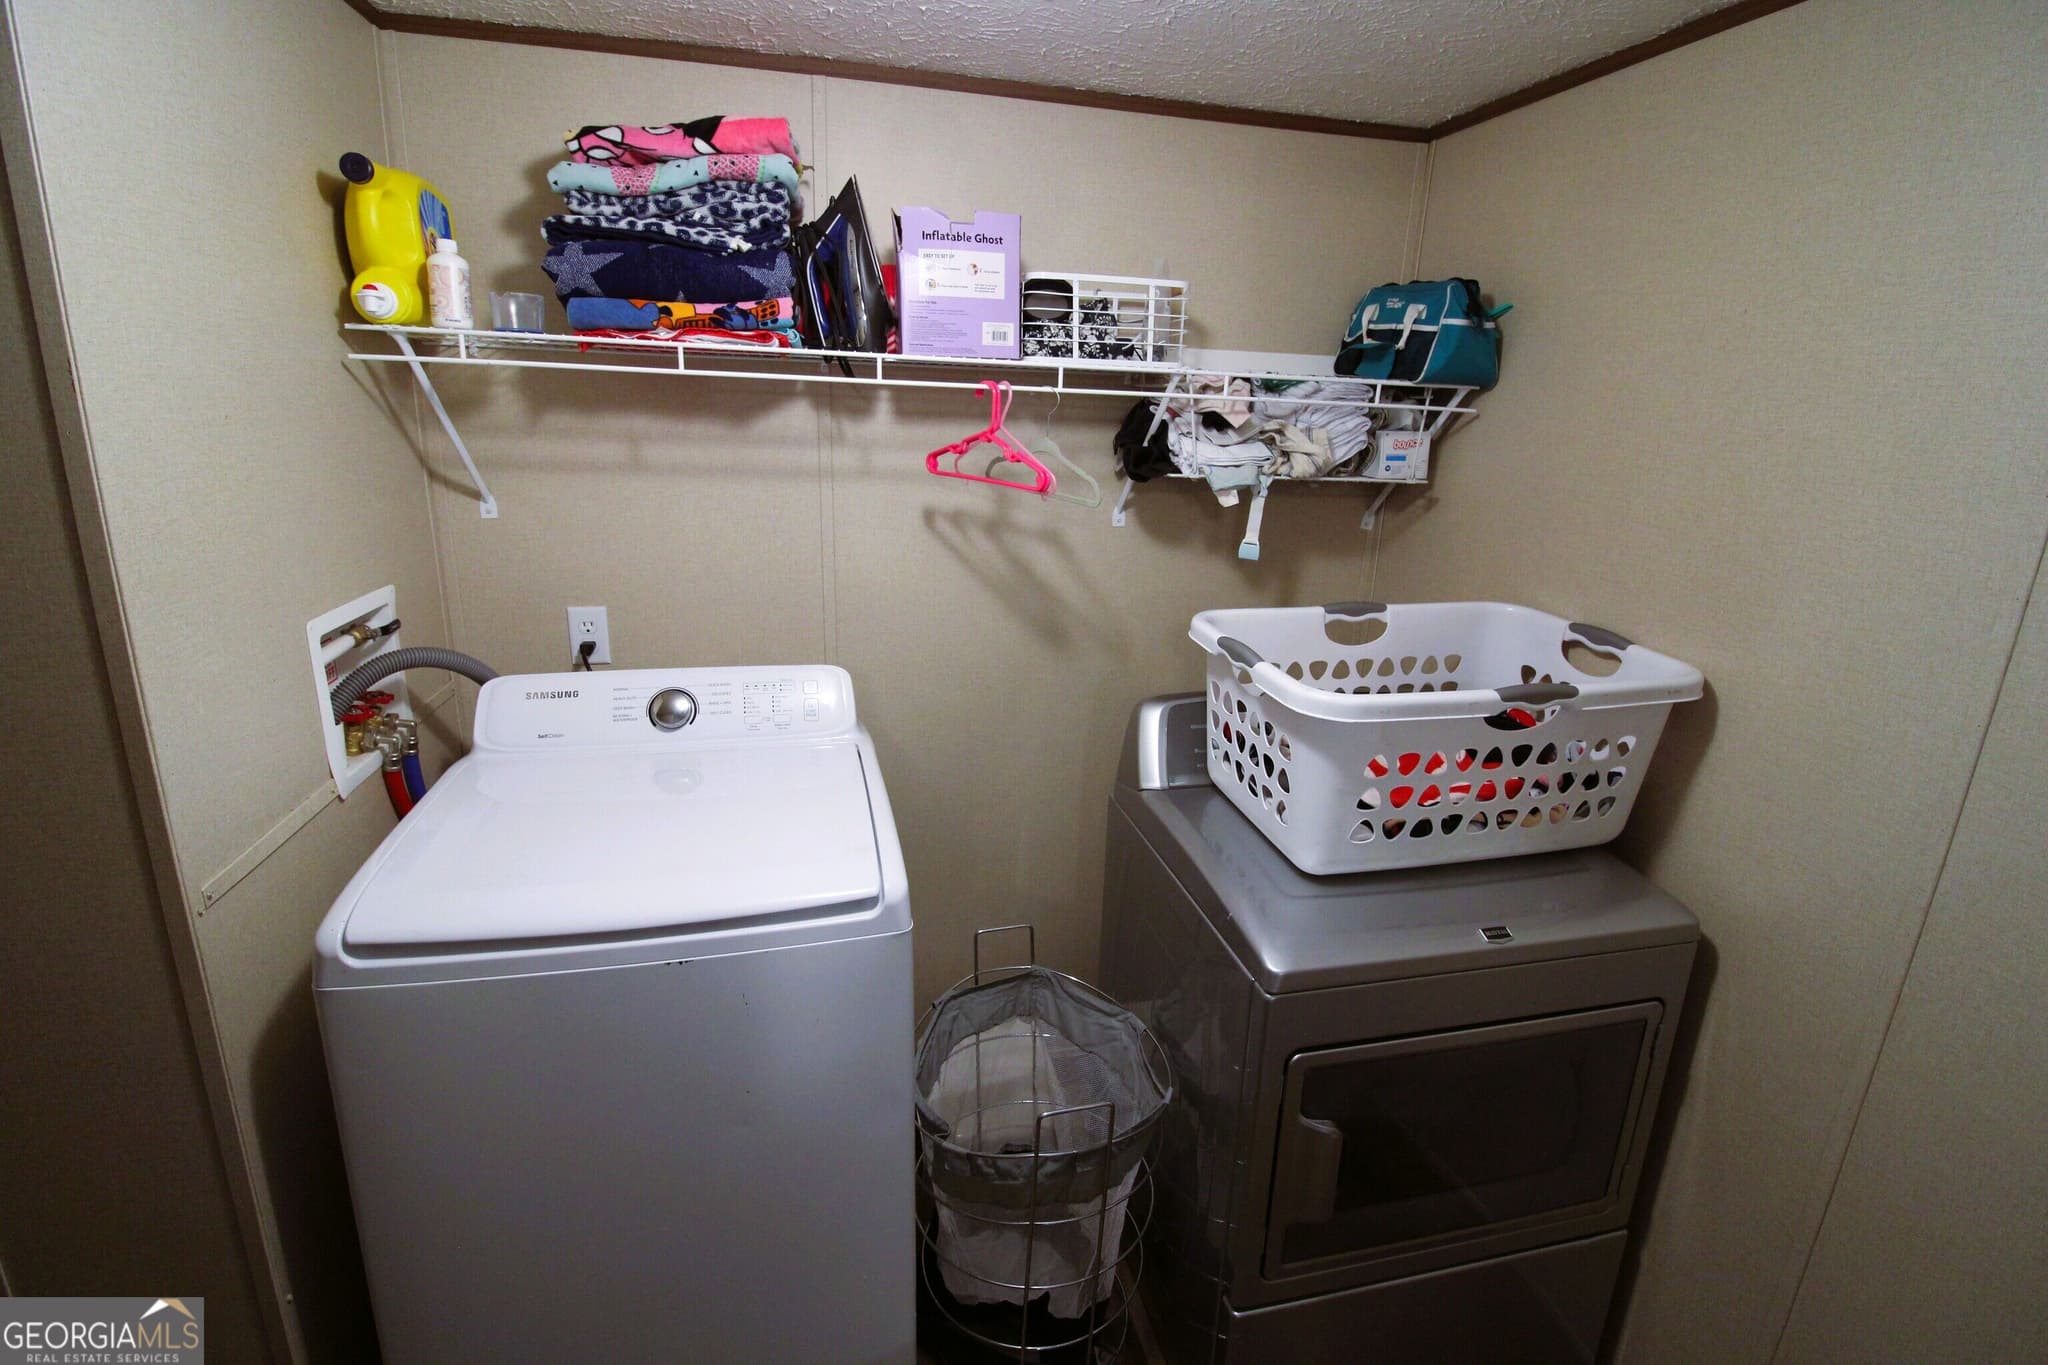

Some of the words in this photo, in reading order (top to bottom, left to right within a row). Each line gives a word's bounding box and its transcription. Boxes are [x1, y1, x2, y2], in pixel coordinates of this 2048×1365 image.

[922, 230, 972, 243] Inflatable
[975, 233, 1004, 245] Ghost
[525, 690, 579, 700] SAMSUNG
